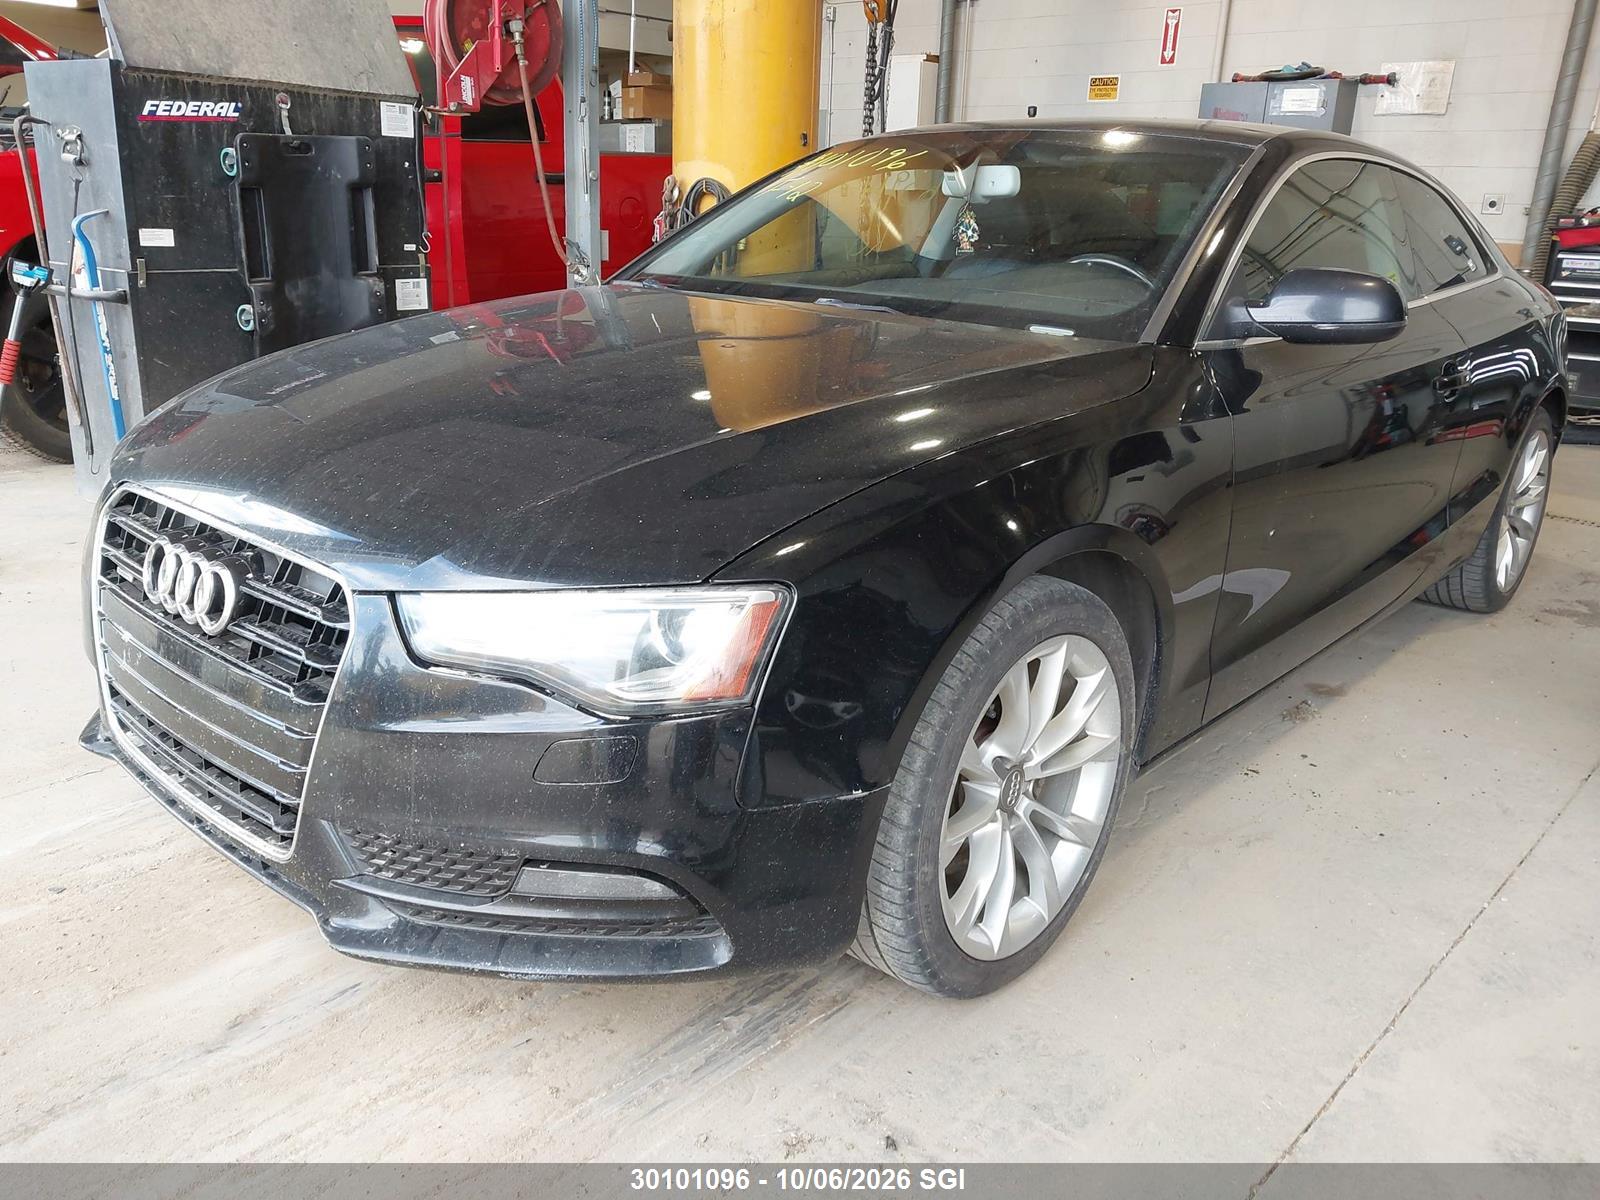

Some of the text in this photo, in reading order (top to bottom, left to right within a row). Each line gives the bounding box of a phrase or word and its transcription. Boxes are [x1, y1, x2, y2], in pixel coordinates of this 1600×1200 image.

[460, 74, 472, 105] LINCOLN
[1091, 78, 1117, 86] CAUTION
[141, 100, 240, 118] FEDERAL
